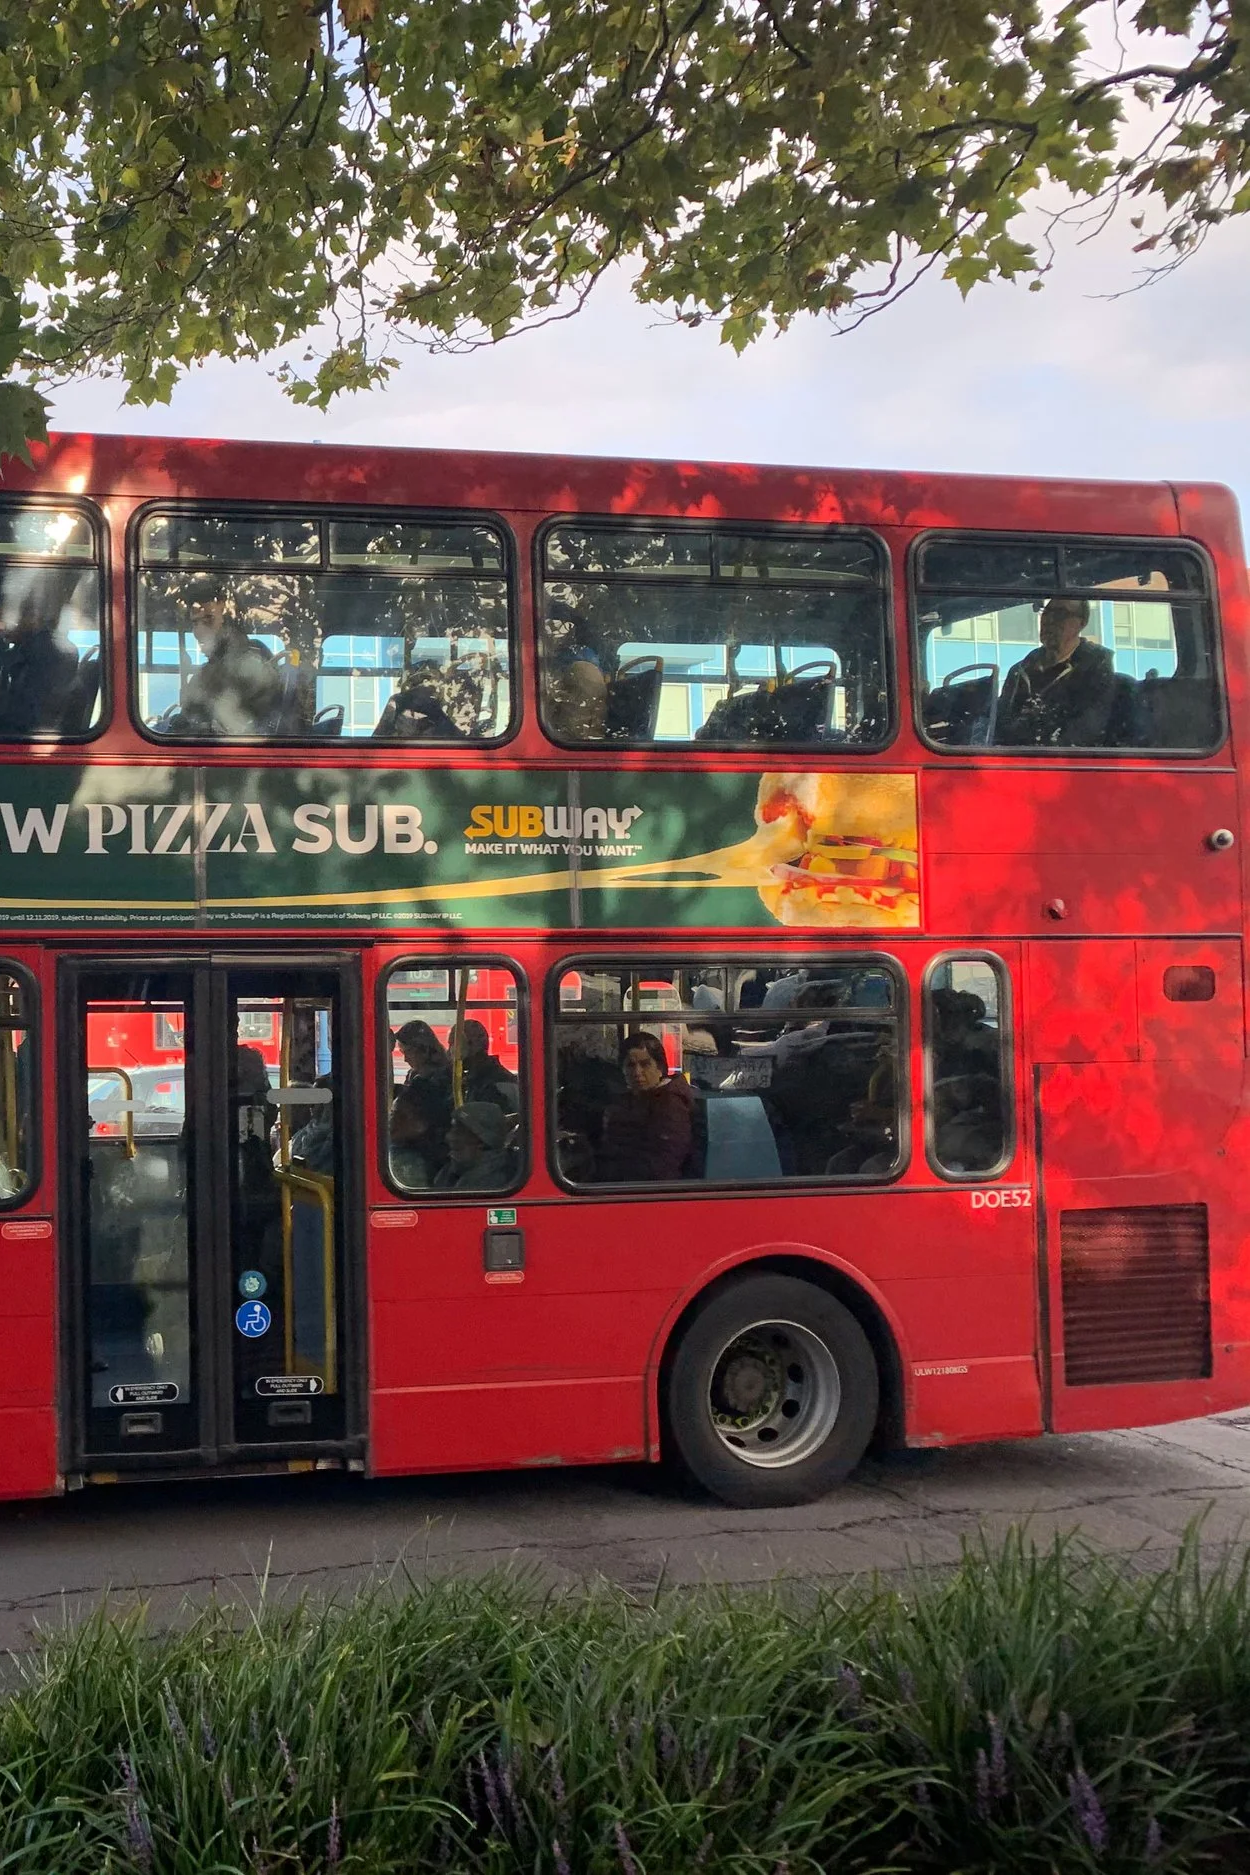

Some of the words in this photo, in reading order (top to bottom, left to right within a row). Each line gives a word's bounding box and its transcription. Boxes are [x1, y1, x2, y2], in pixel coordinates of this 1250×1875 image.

[84, 802, 277, 854] PIZZA
[292, 803, 438, 854] SUB.
[465, 843, 503, 855] MAKE
[505, 843, 517, 854] IT
[520, 843, 562, 855] WHAT
[563, 844, 592, 856] YOU
[61, 914, 84, 922] subject
[346, 912, 370, 920] Subway
[971, 1190, 1032, 1209] DOE52
